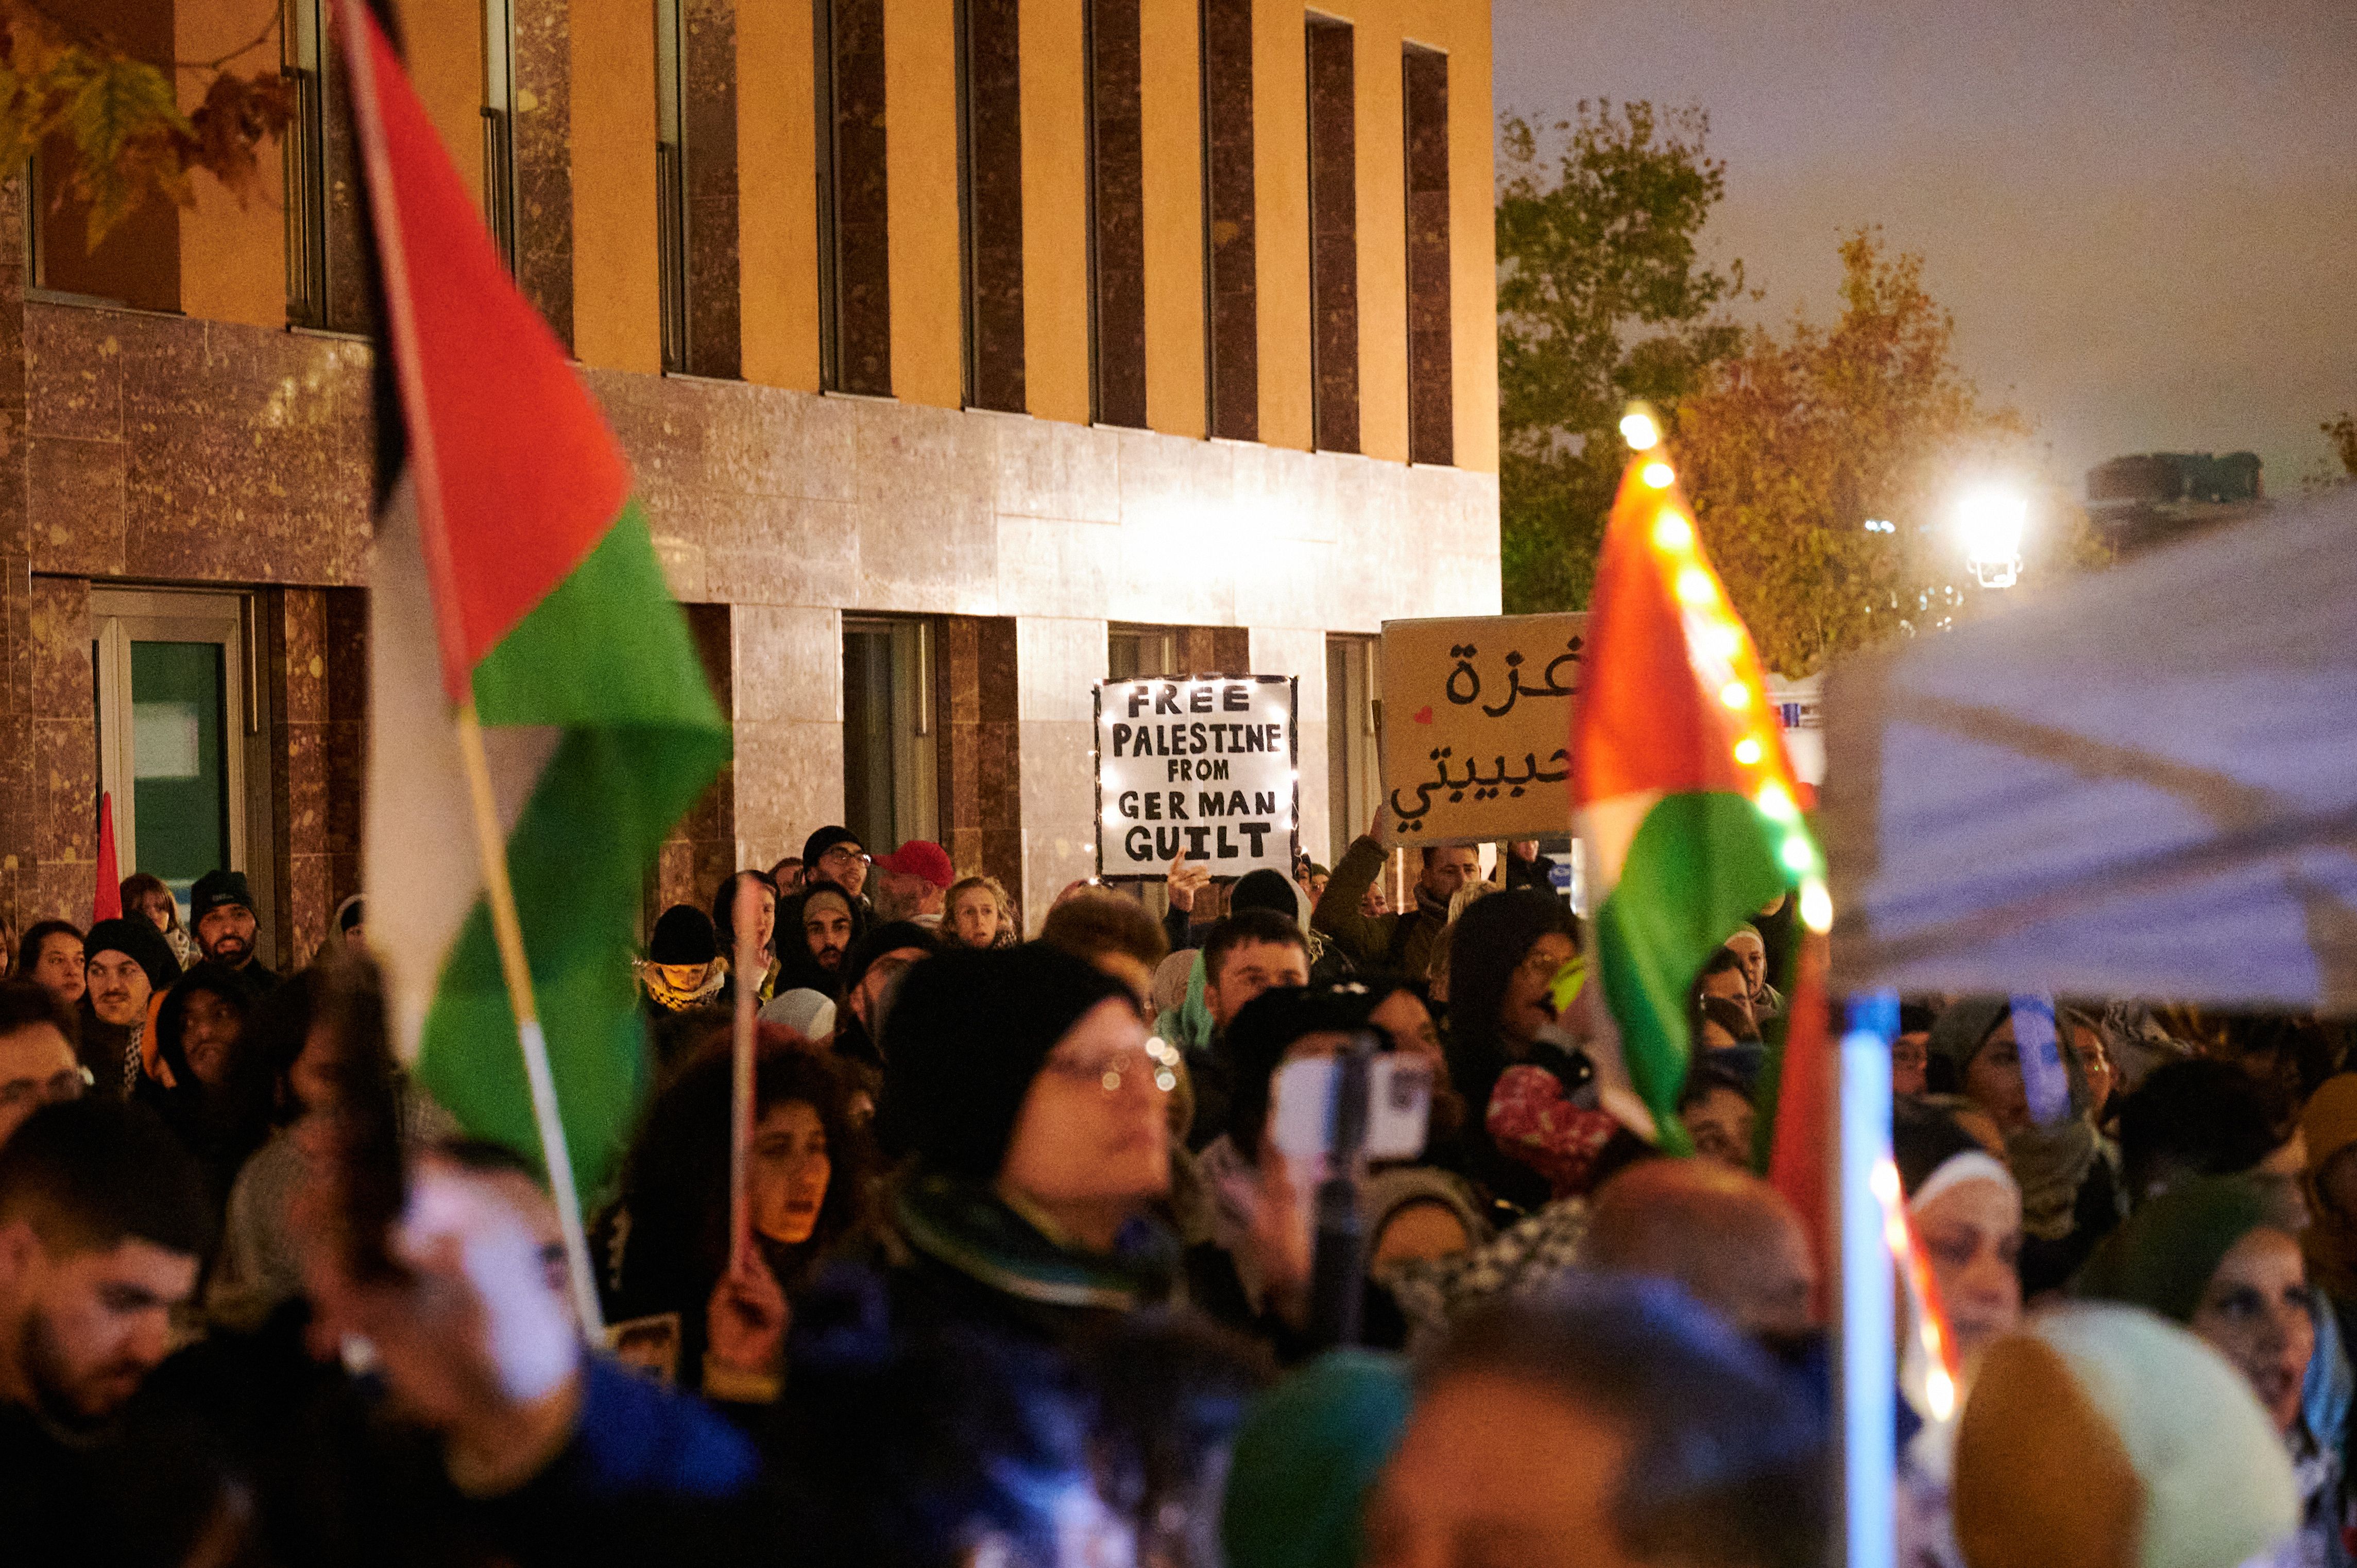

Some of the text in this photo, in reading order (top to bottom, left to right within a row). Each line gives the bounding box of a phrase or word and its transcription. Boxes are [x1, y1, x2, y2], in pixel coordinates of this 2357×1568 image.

[1446, 635, 1585, 718] غزة
[1128, 684, 1250, 718] FREE
[1112, 722, 1282, 757] PALESTINE
[1168, 759, 1229, 782] FROM
[1118, 790, 1276, 820] GERMAN
[1125, 822, 1271, 861] GUILT
